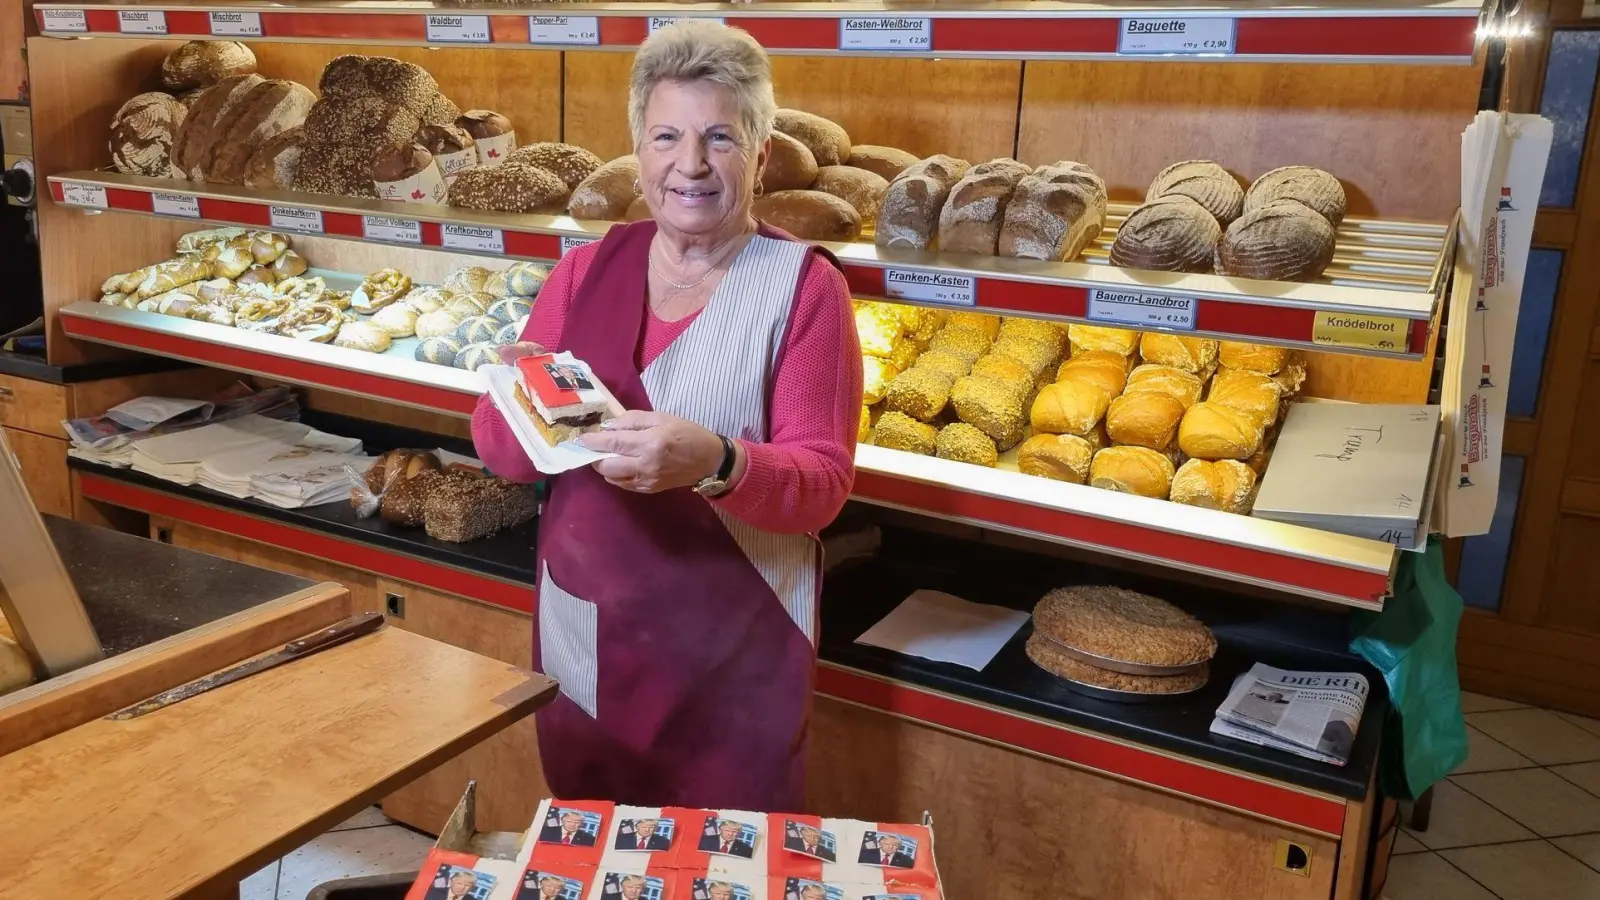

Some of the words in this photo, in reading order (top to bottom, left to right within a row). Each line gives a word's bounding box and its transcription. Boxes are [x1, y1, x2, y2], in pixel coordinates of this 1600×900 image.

[121, 12, 149, 20] Mischbrot
[212, 13, 243, 21] Mischbrot
[430, 16, 463, 26] Waldbrot
[846, 19, 923, 29] Kasten-Weißbrot
[1128, 20, 1186, 33] Baguette
[1210, 41, 1227, 50] 2,90
[272, 206, 317, 219] Dinkelsaftkorn
[389, 219, 416, 230] Vollkorn
[445, 225, 494, 238] Kraftkornbrot
[889, 270, 969, 287] Franken-Kasten
[1096, 291, 1189, 308] Bauern-Landbrot
[1173, 315, 1189, 323] 2,50
[1327, 316, 1396, 332] Knödelbrot
[1467, 394, 1481, 464] Baguette
[1379, 528, 1411, 545] 14
[1280, 675, 1321, 686] DIE
